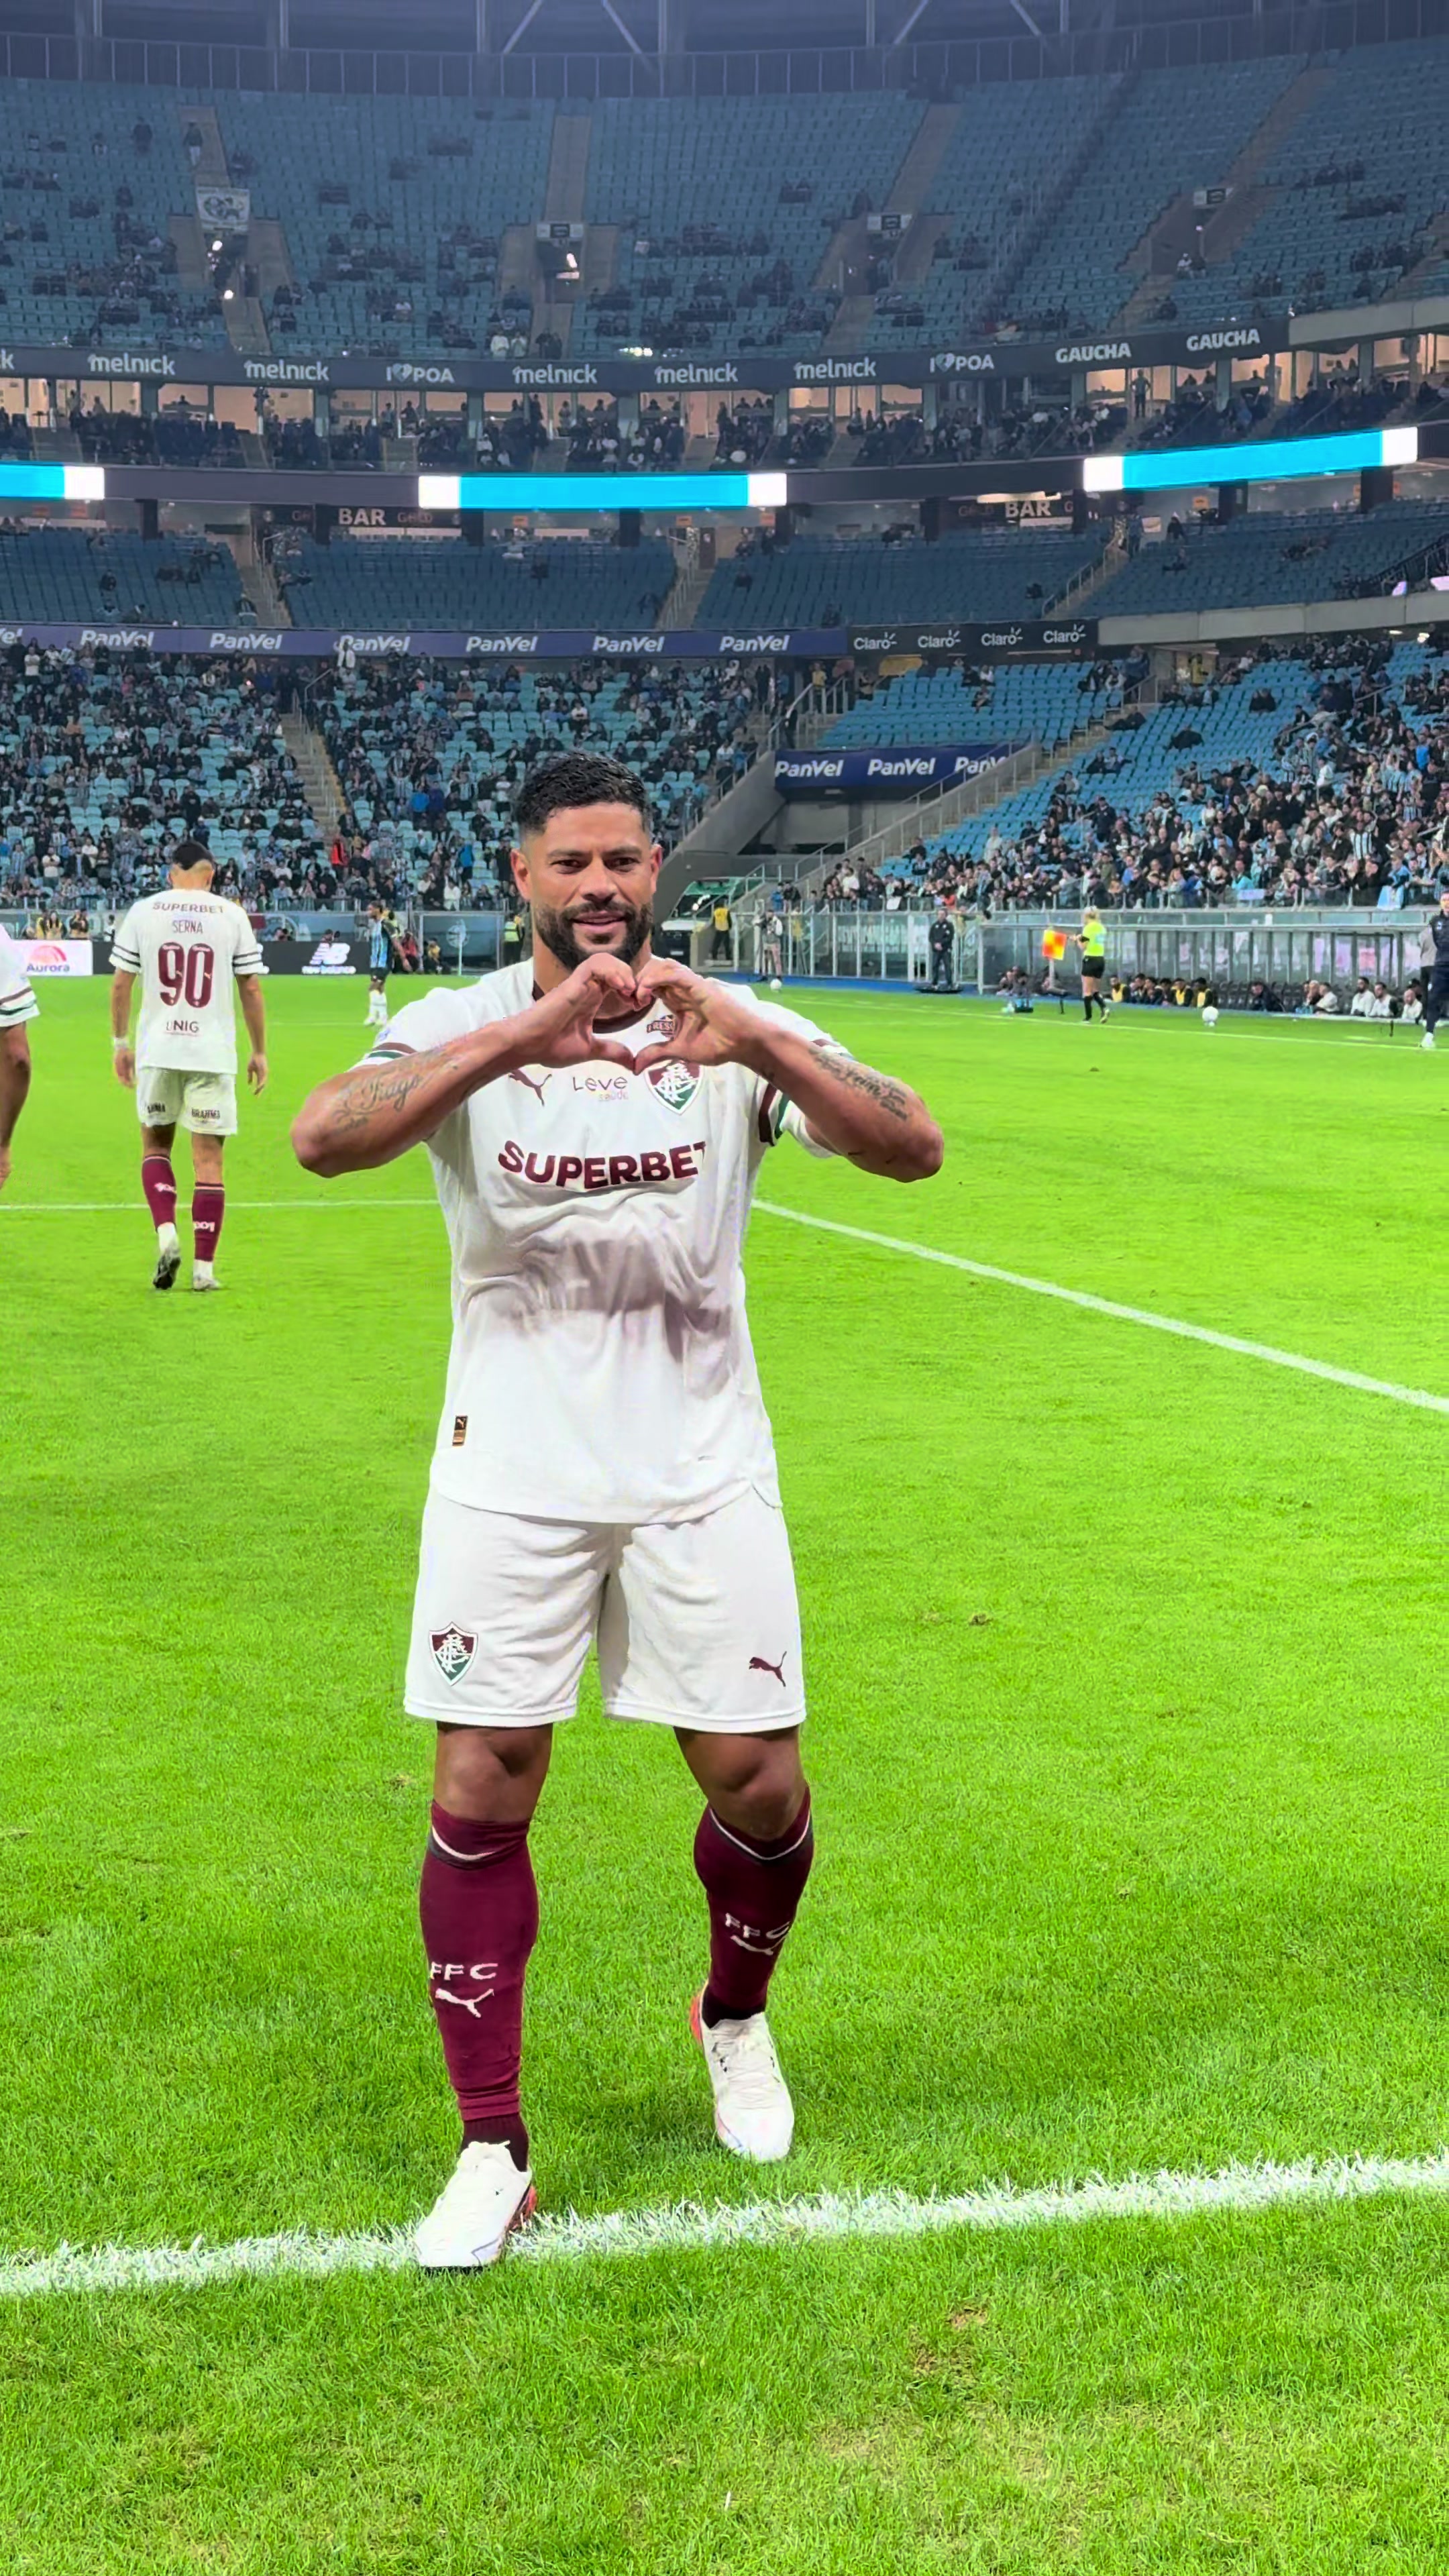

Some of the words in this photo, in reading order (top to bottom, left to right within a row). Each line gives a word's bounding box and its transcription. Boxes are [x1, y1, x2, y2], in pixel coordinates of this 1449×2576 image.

[1186, 328, 1260, 352] GAUCHA
[1056, 342, 1132, 364] GAUCHA
[88, 352, 176, 376] melnick
[244, 358, 329, 382] melnick
[793, 356, 877, 380] melnick
[955, 354, 995, 371] POA
[413, 367, 455, 383] POA
[513, 363, 598, 385] melnick
[655, 361, 739, 384] melnick
[338, 508, 386, 526] BAR
[1005, 500, 1051, 518] BAR
[80, 629, 155, 647] PanVel
[209, 632, 282, 651] PanVel
[340, 635, 411, 652] PanVel
[466, 635, 538, 653] PanVel
[592, 636, 665, 653] PanVel
[720, 635, 790, 652] PanVel
[853, 636, 892, 651] Claro
[918, 634, 955, 649] Claro
[981, 632, 1017, 647] Claro
[1043, 629, 1080, 643] Claro
[775, 759, 844, 779] PanVel
[867, 758, 936, 777] PanVel
[152, 901, 224, 914] SUPERBET
[172, 919, 203, 934] SERNA
[26, 963, 70, 973] Aurora
[158, 941, 215, 1008] 90
[572, 1076, 628, 1091] Leve
[724, 1912, 791, 1939] FFC
[429, 1961, 498, 1981] FFC
